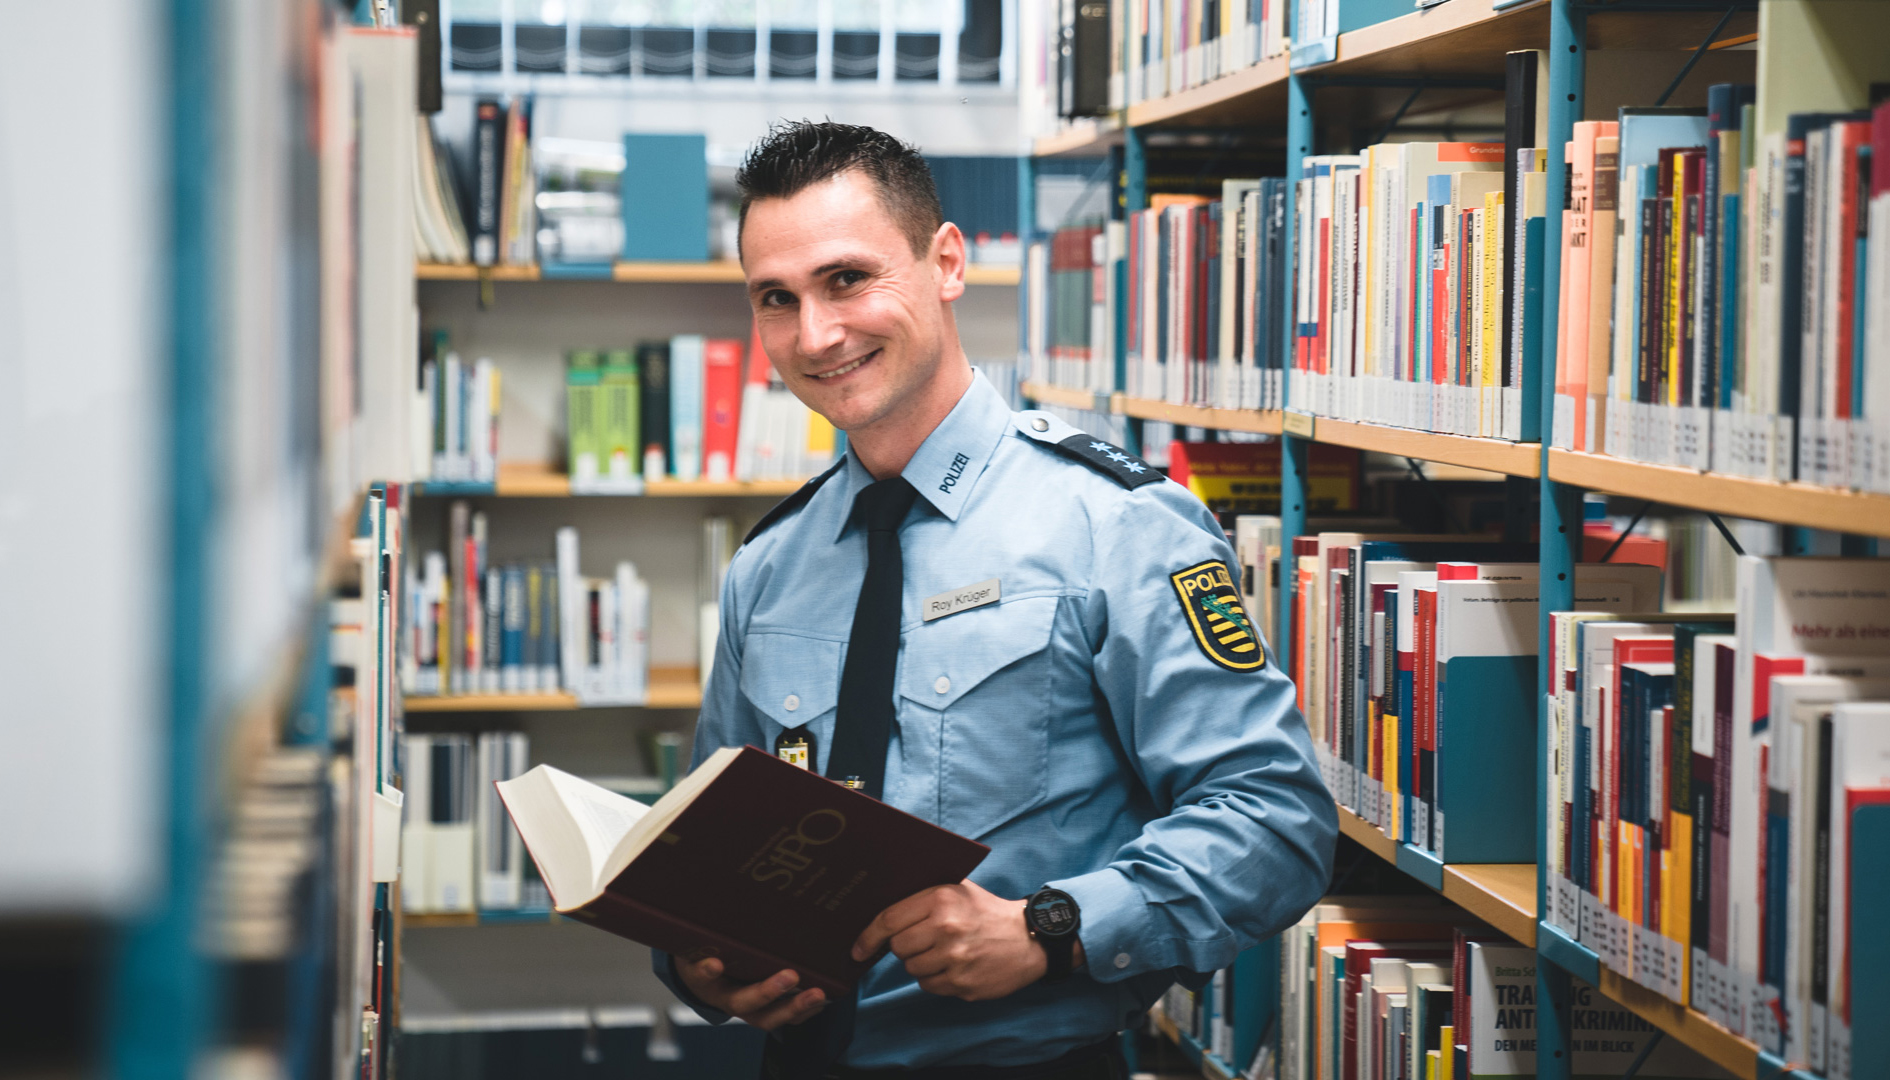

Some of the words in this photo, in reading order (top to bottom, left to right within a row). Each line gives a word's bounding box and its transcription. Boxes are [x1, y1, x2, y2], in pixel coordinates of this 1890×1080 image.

[939, 452, 970, 494] POLIZEI
[931, 600, 952, 613] Roy
[955, 588, 991, 606] Krüger
[751, 808, 846, 891] StPO
[1495, 966, 1521, 976] Britta
[1495, 1040, 1517, 1051] DEN
[1602, 1041, 1635, 1053] BLICK
